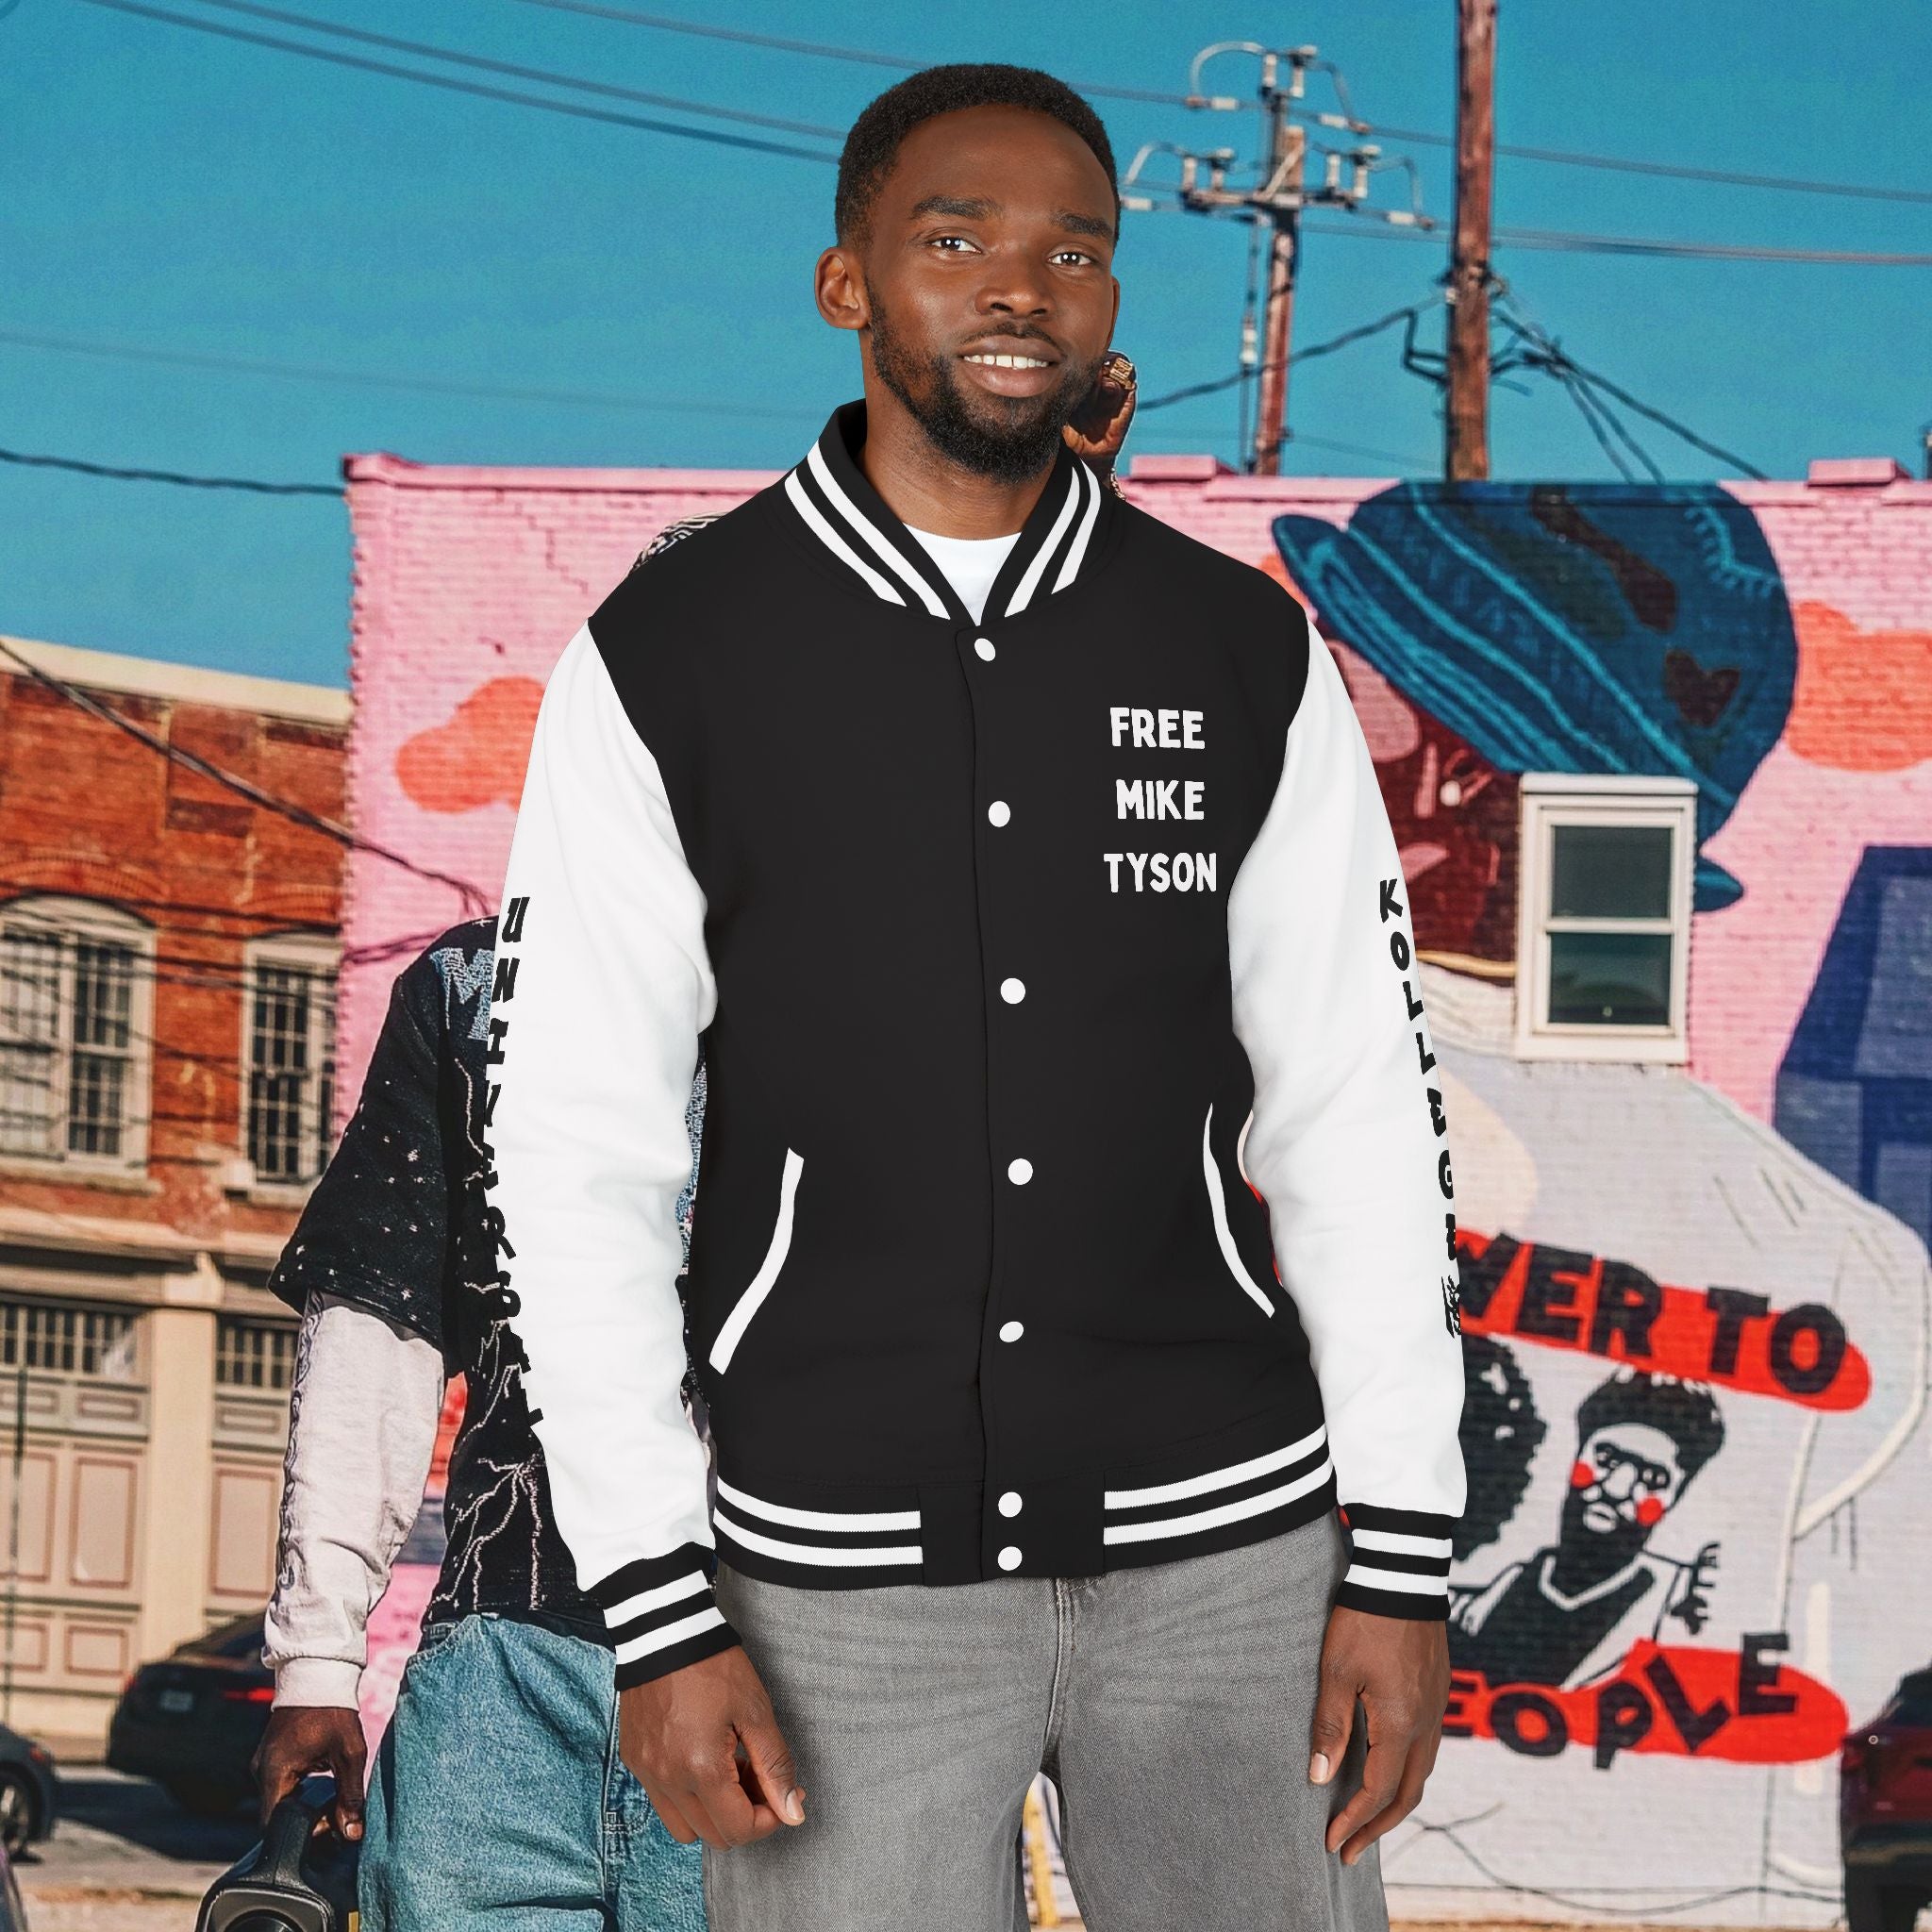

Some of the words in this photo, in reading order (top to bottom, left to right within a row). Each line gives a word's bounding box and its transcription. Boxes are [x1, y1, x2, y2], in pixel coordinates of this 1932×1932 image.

[1109, 707, 1206, 749] FREE
[1116, 778, 1206, 821] MIKE
[1103, 852, 1217, 892] TYSON
[1704, 1287, 1847, 1394] TO
[1441, 1632, 1797, 1770] EOPLE
